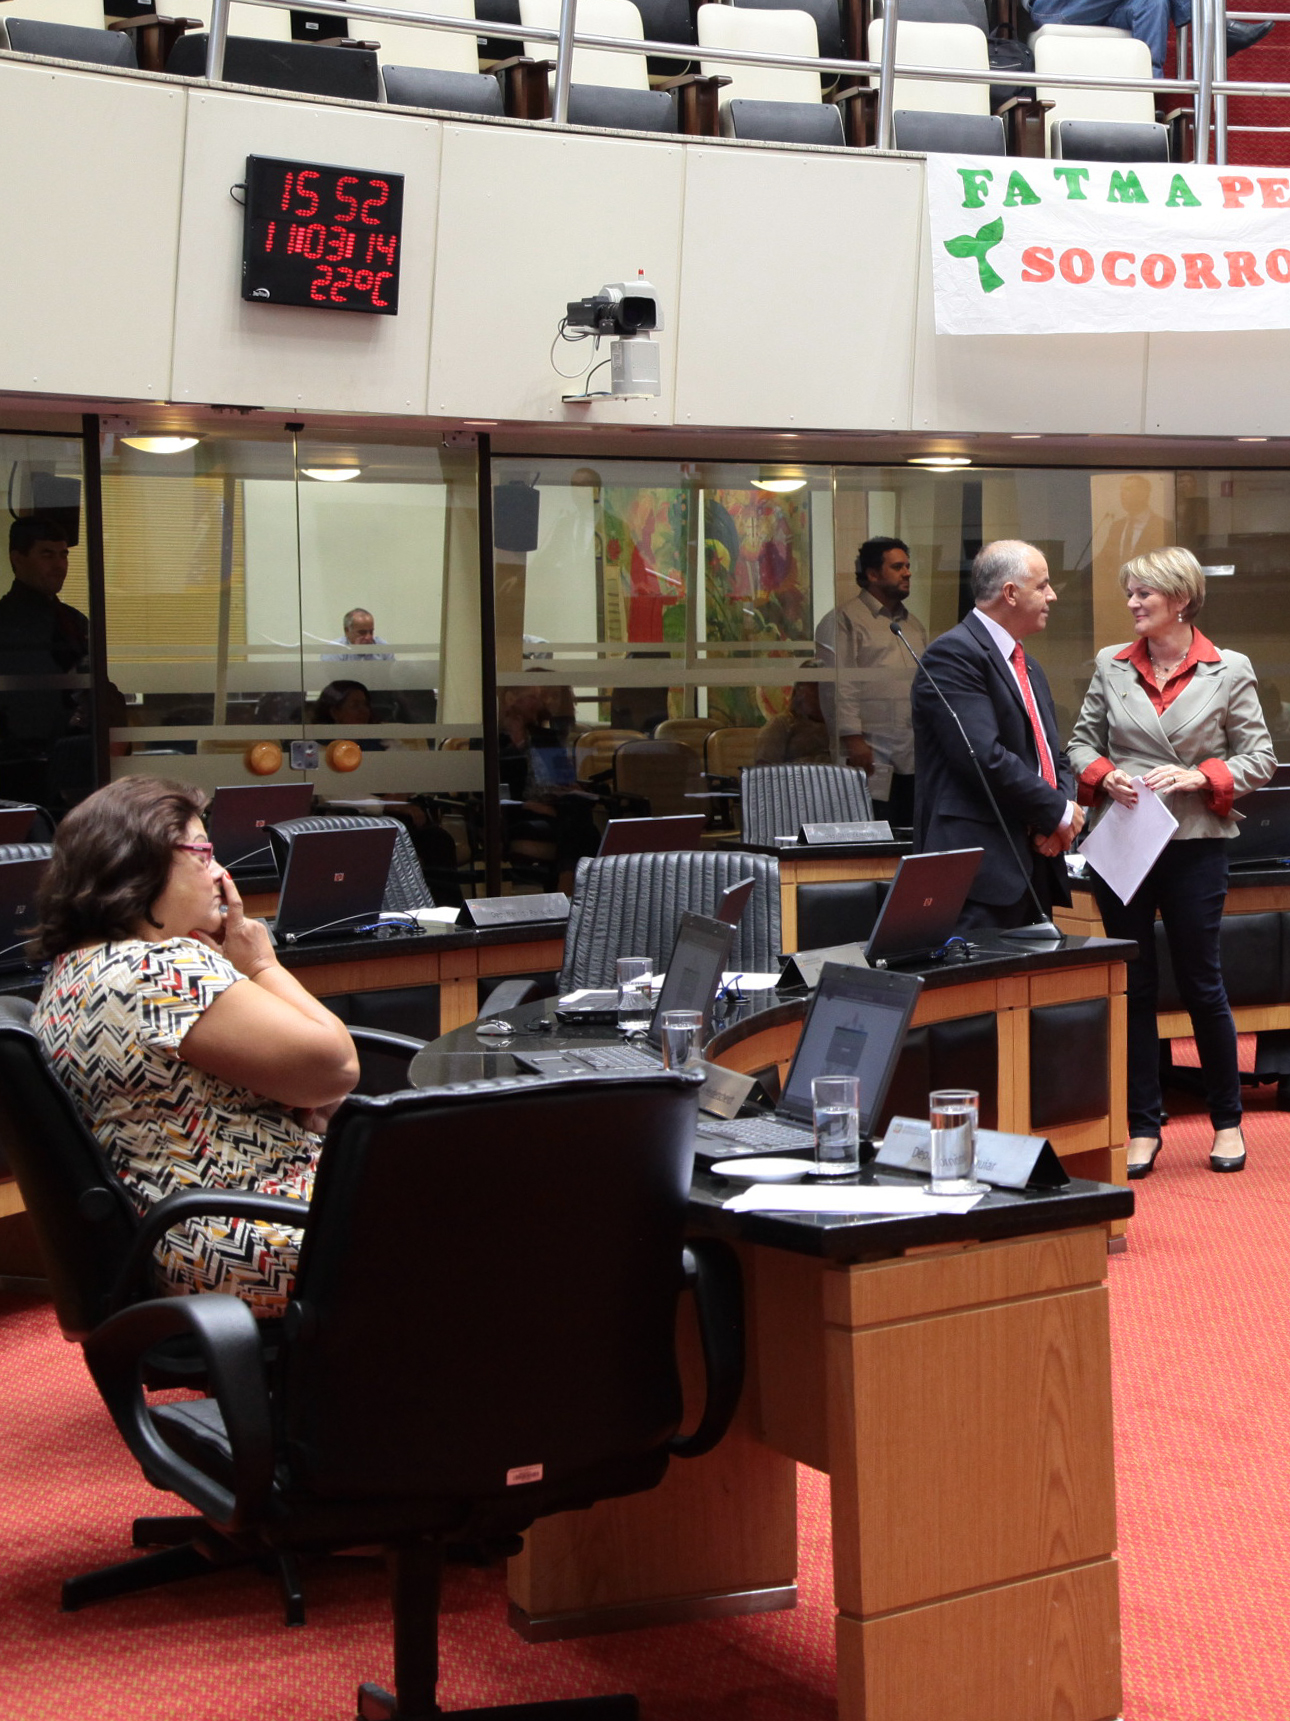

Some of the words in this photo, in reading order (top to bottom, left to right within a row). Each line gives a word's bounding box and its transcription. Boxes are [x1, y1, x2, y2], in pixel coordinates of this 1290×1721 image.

[281, 170, 320, 217] 15
[334, 176, 390, 225] 52
[956, 167, 1202, 209] FATMA
[911, 1146, 930, 1162] Dep.
